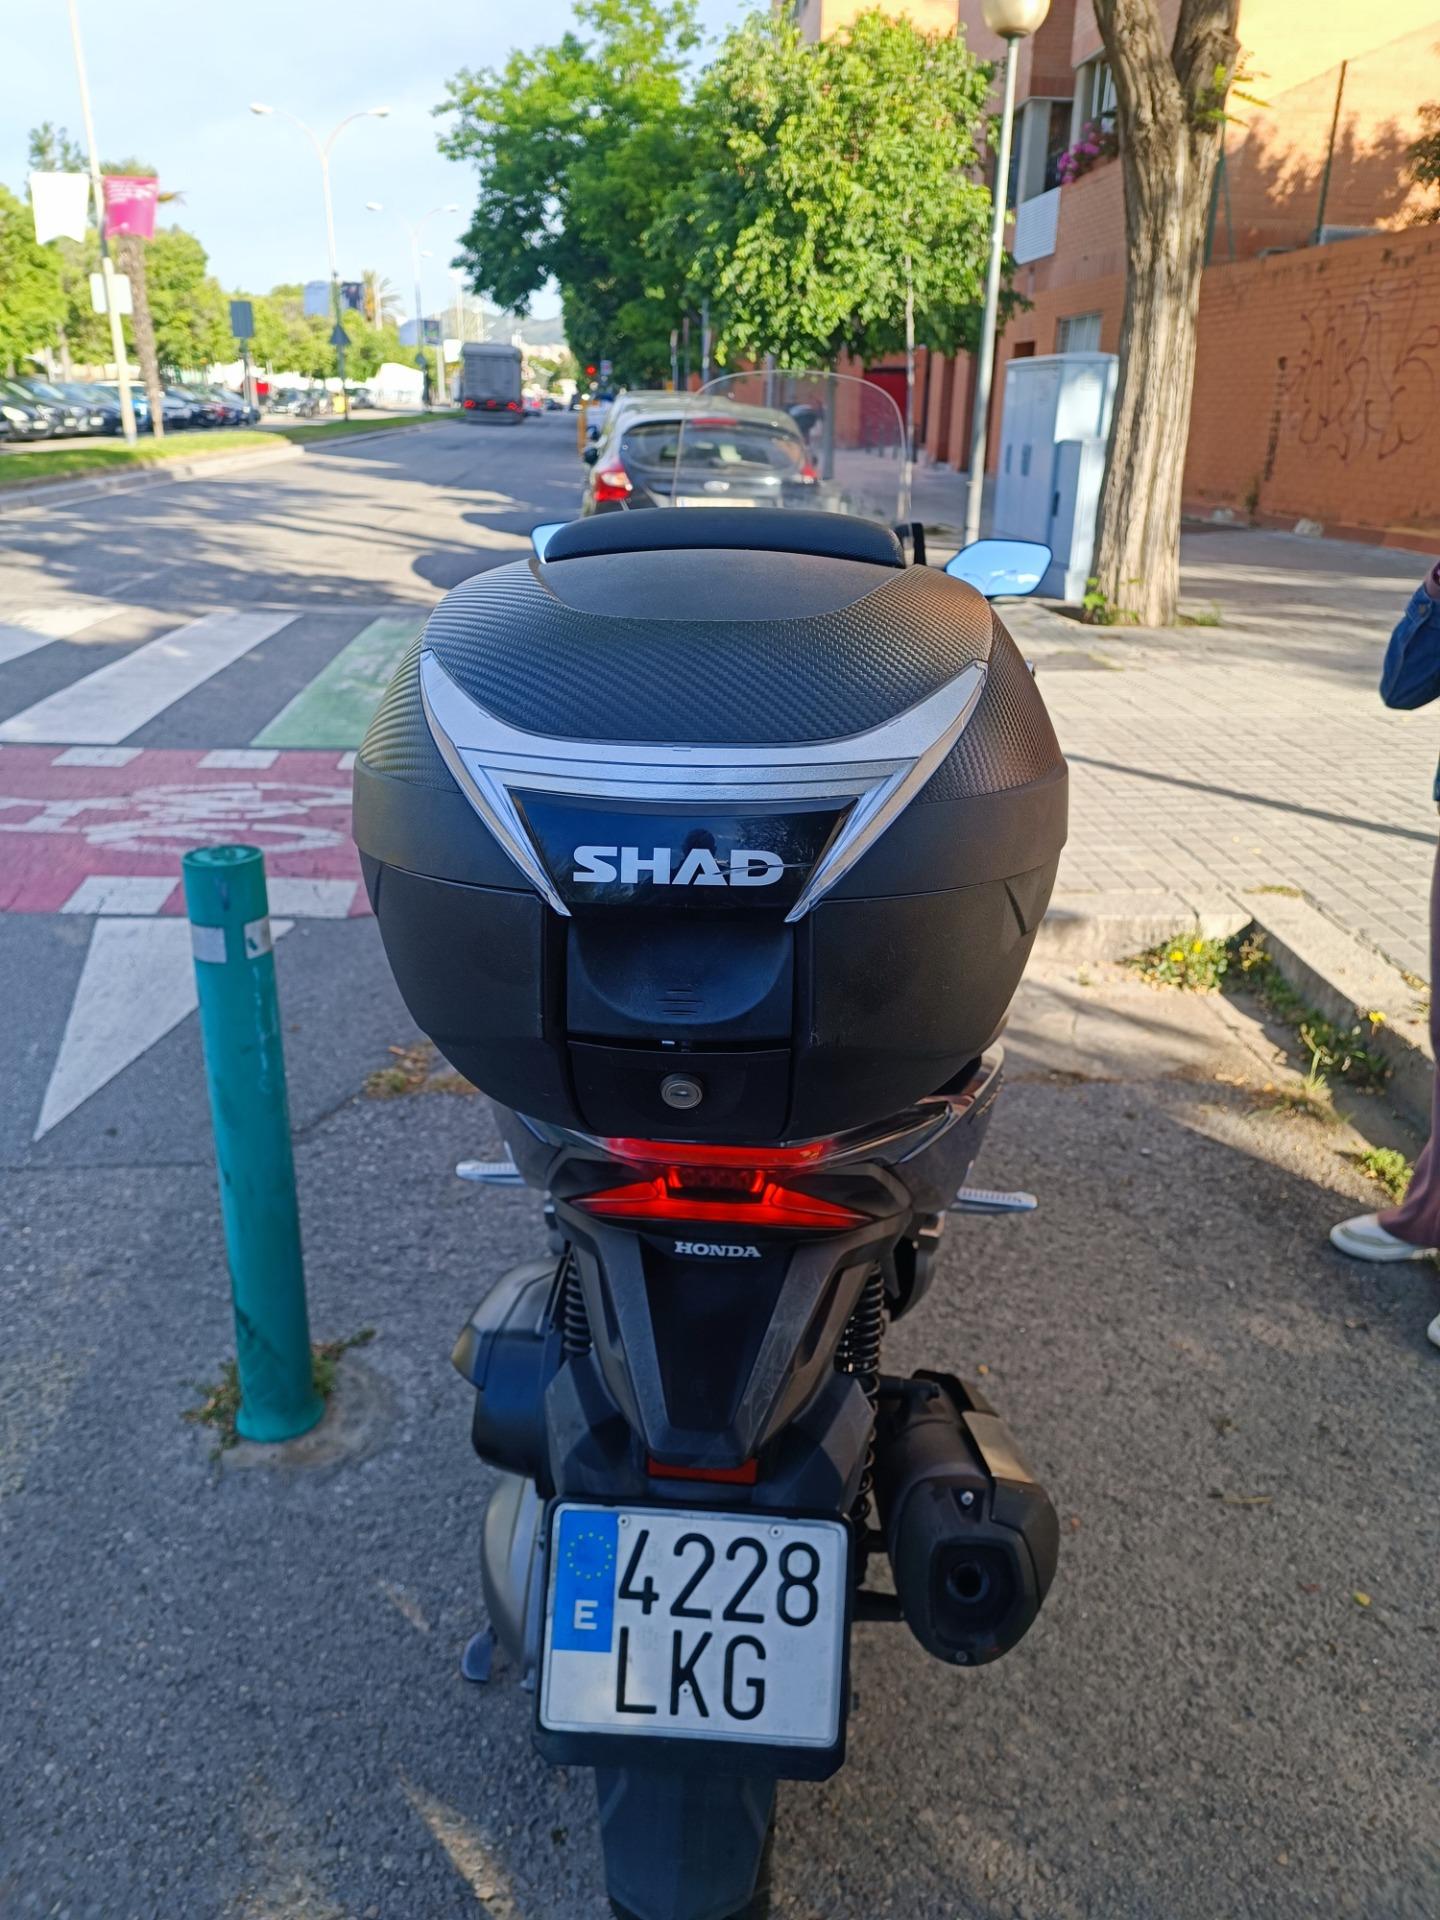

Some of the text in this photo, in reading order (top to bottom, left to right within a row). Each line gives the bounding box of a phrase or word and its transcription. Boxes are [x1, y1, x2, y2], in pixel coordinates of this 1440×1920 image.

[573, 846, 784, 886] SHAD
[675, 1241, 761, 1258] HONDA
[618, 1529, 820, 1627] 4228
[573, 1599, 598, 1630] E
[615, 1625, 766, 1720] LKG
